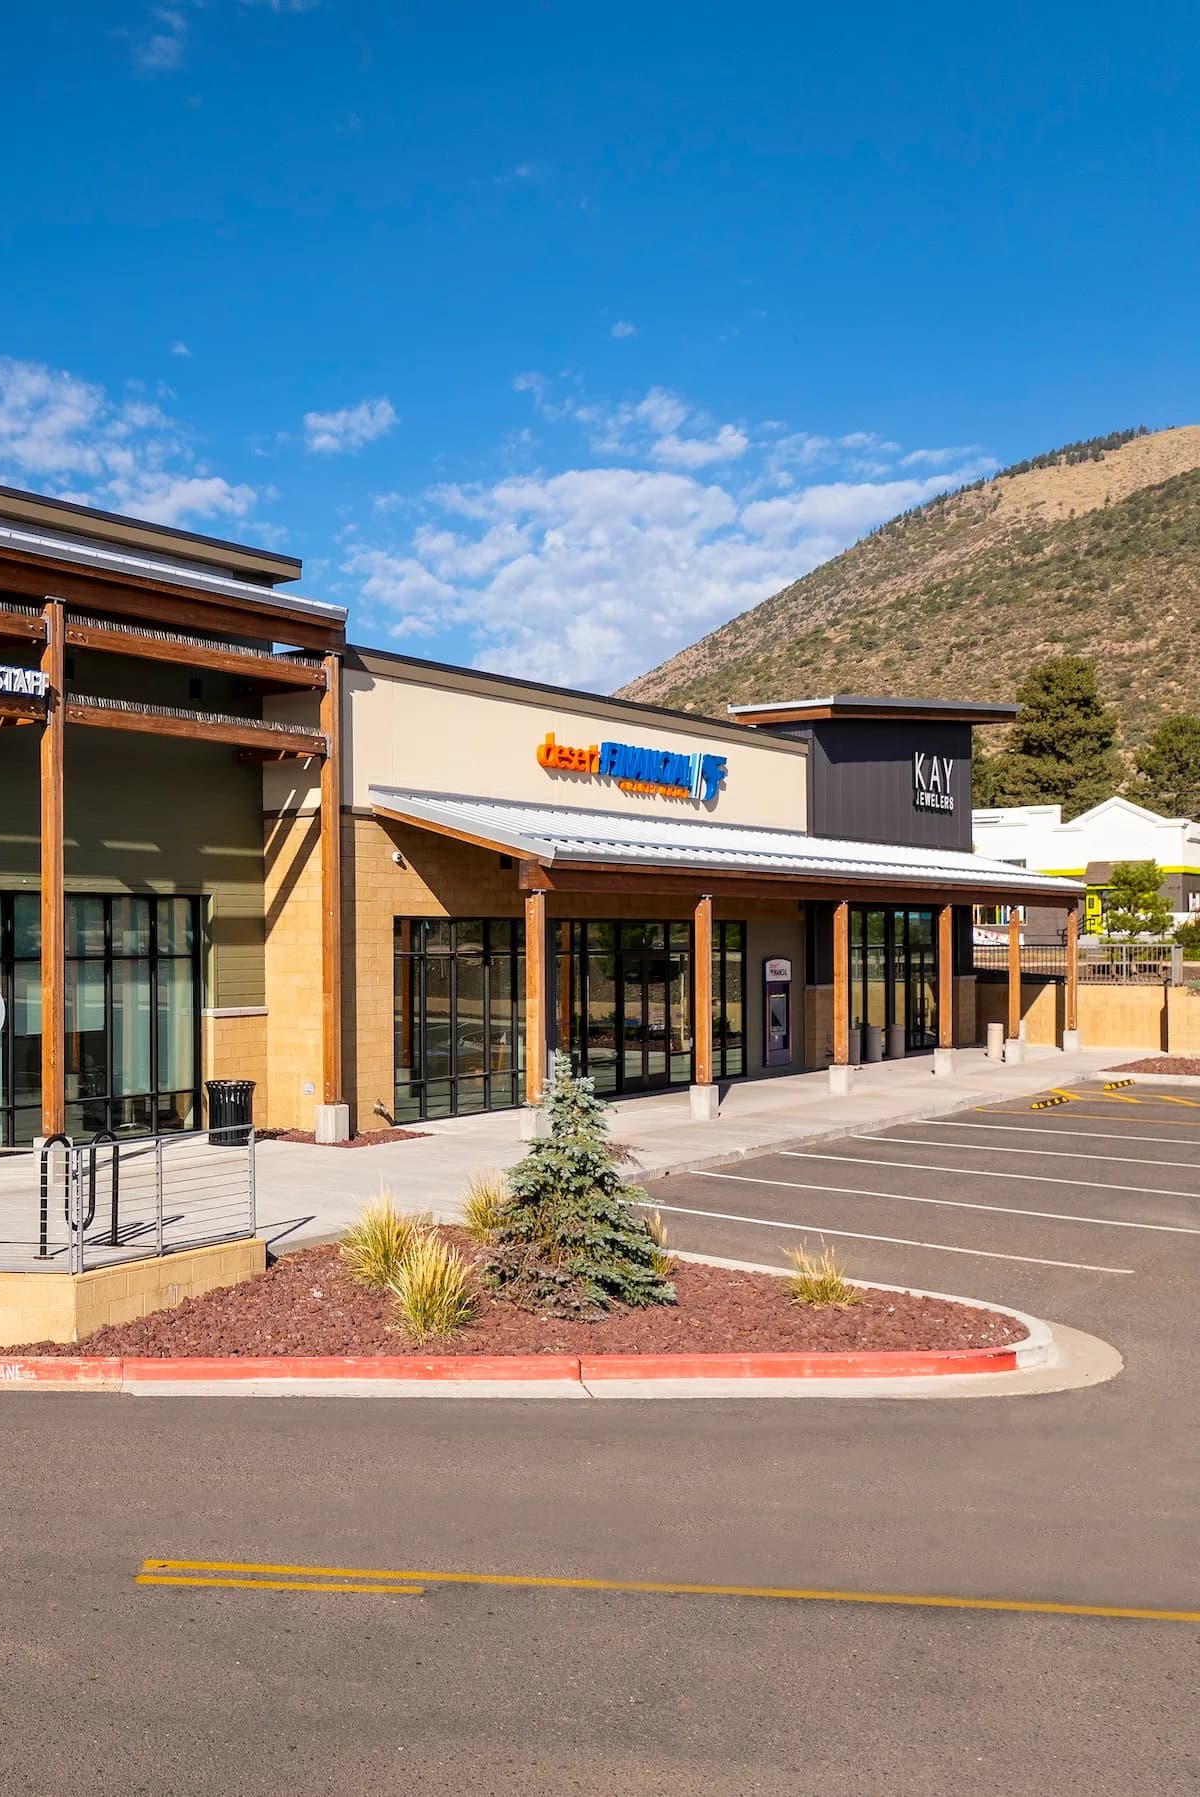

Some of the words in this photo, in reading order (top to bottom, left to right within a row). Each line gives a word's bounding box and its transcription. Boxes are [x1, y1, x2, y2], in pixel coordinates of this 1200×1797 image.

[537, 732, 599, 775] desert
[915, 751, 954, 794] KAY
[916, 791, 954, 811] JEWELERS
